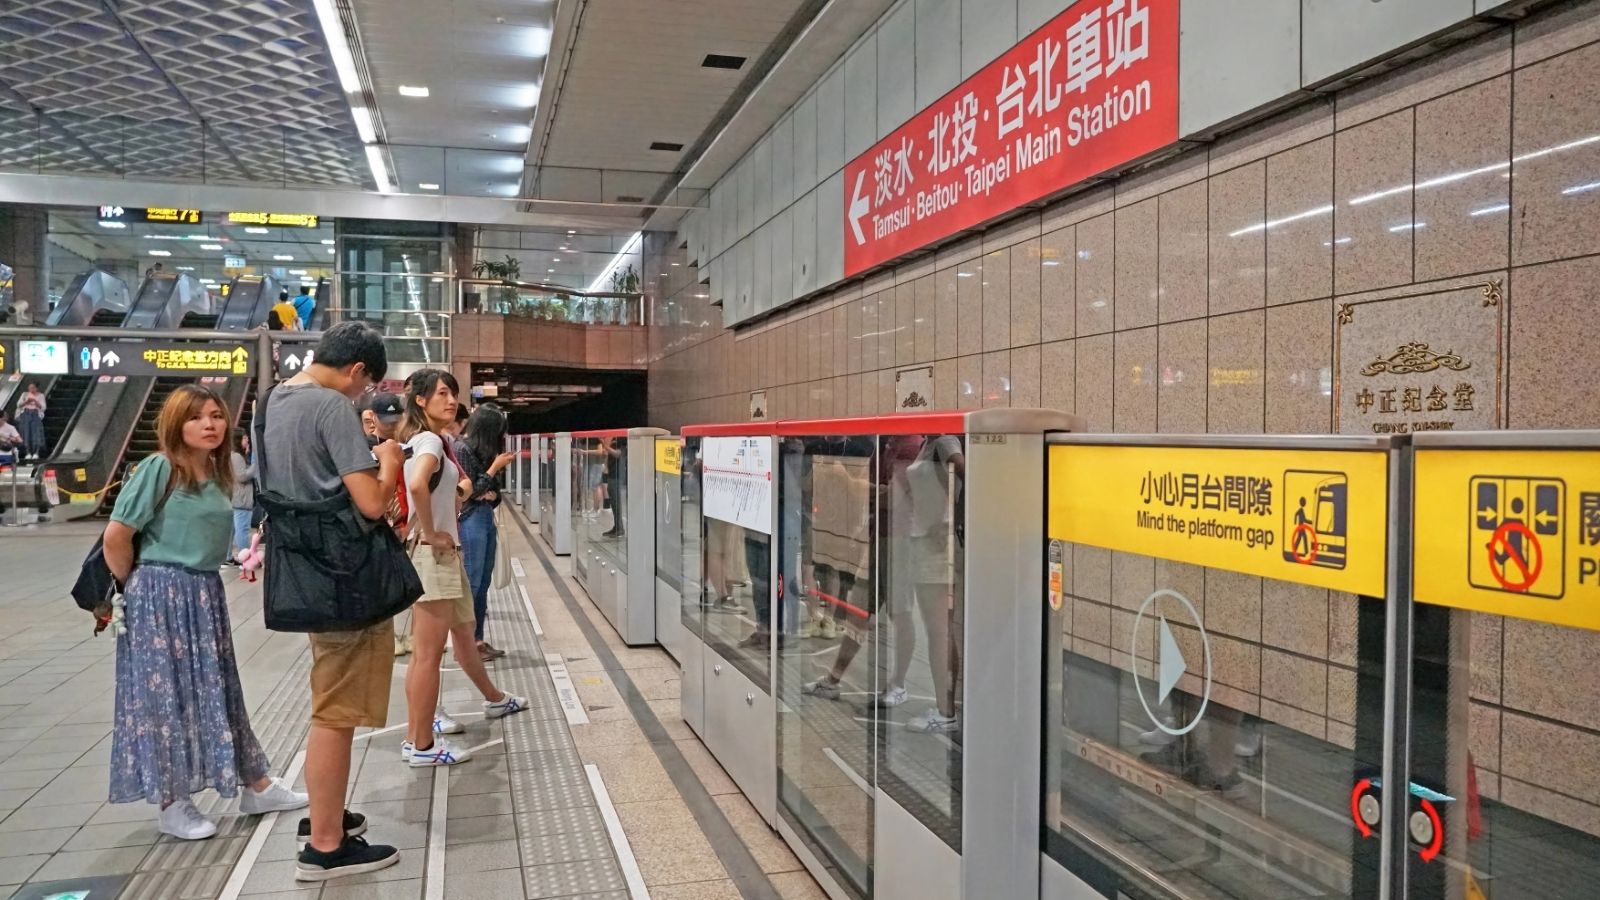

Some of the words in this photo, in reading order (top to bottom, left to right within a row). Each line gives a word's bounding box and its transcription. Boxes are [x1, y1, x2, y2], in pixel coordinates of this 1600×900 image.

[1015, 124, 1061, 174] Main
[1067, 79, 1151, 148] Station
[1355, 382, 1475, 415] 中正紀念堂
[1372, 422, 1408, 434] CHANG
[1139, 470, 1273, 517] 小心月台間隙
[1136, 510, 1164, 532] Mind
[1167, 514, 1186, 534] the
[1188, 517, 1242, 541] platform
[1246, 526, 1274, 551] gap
